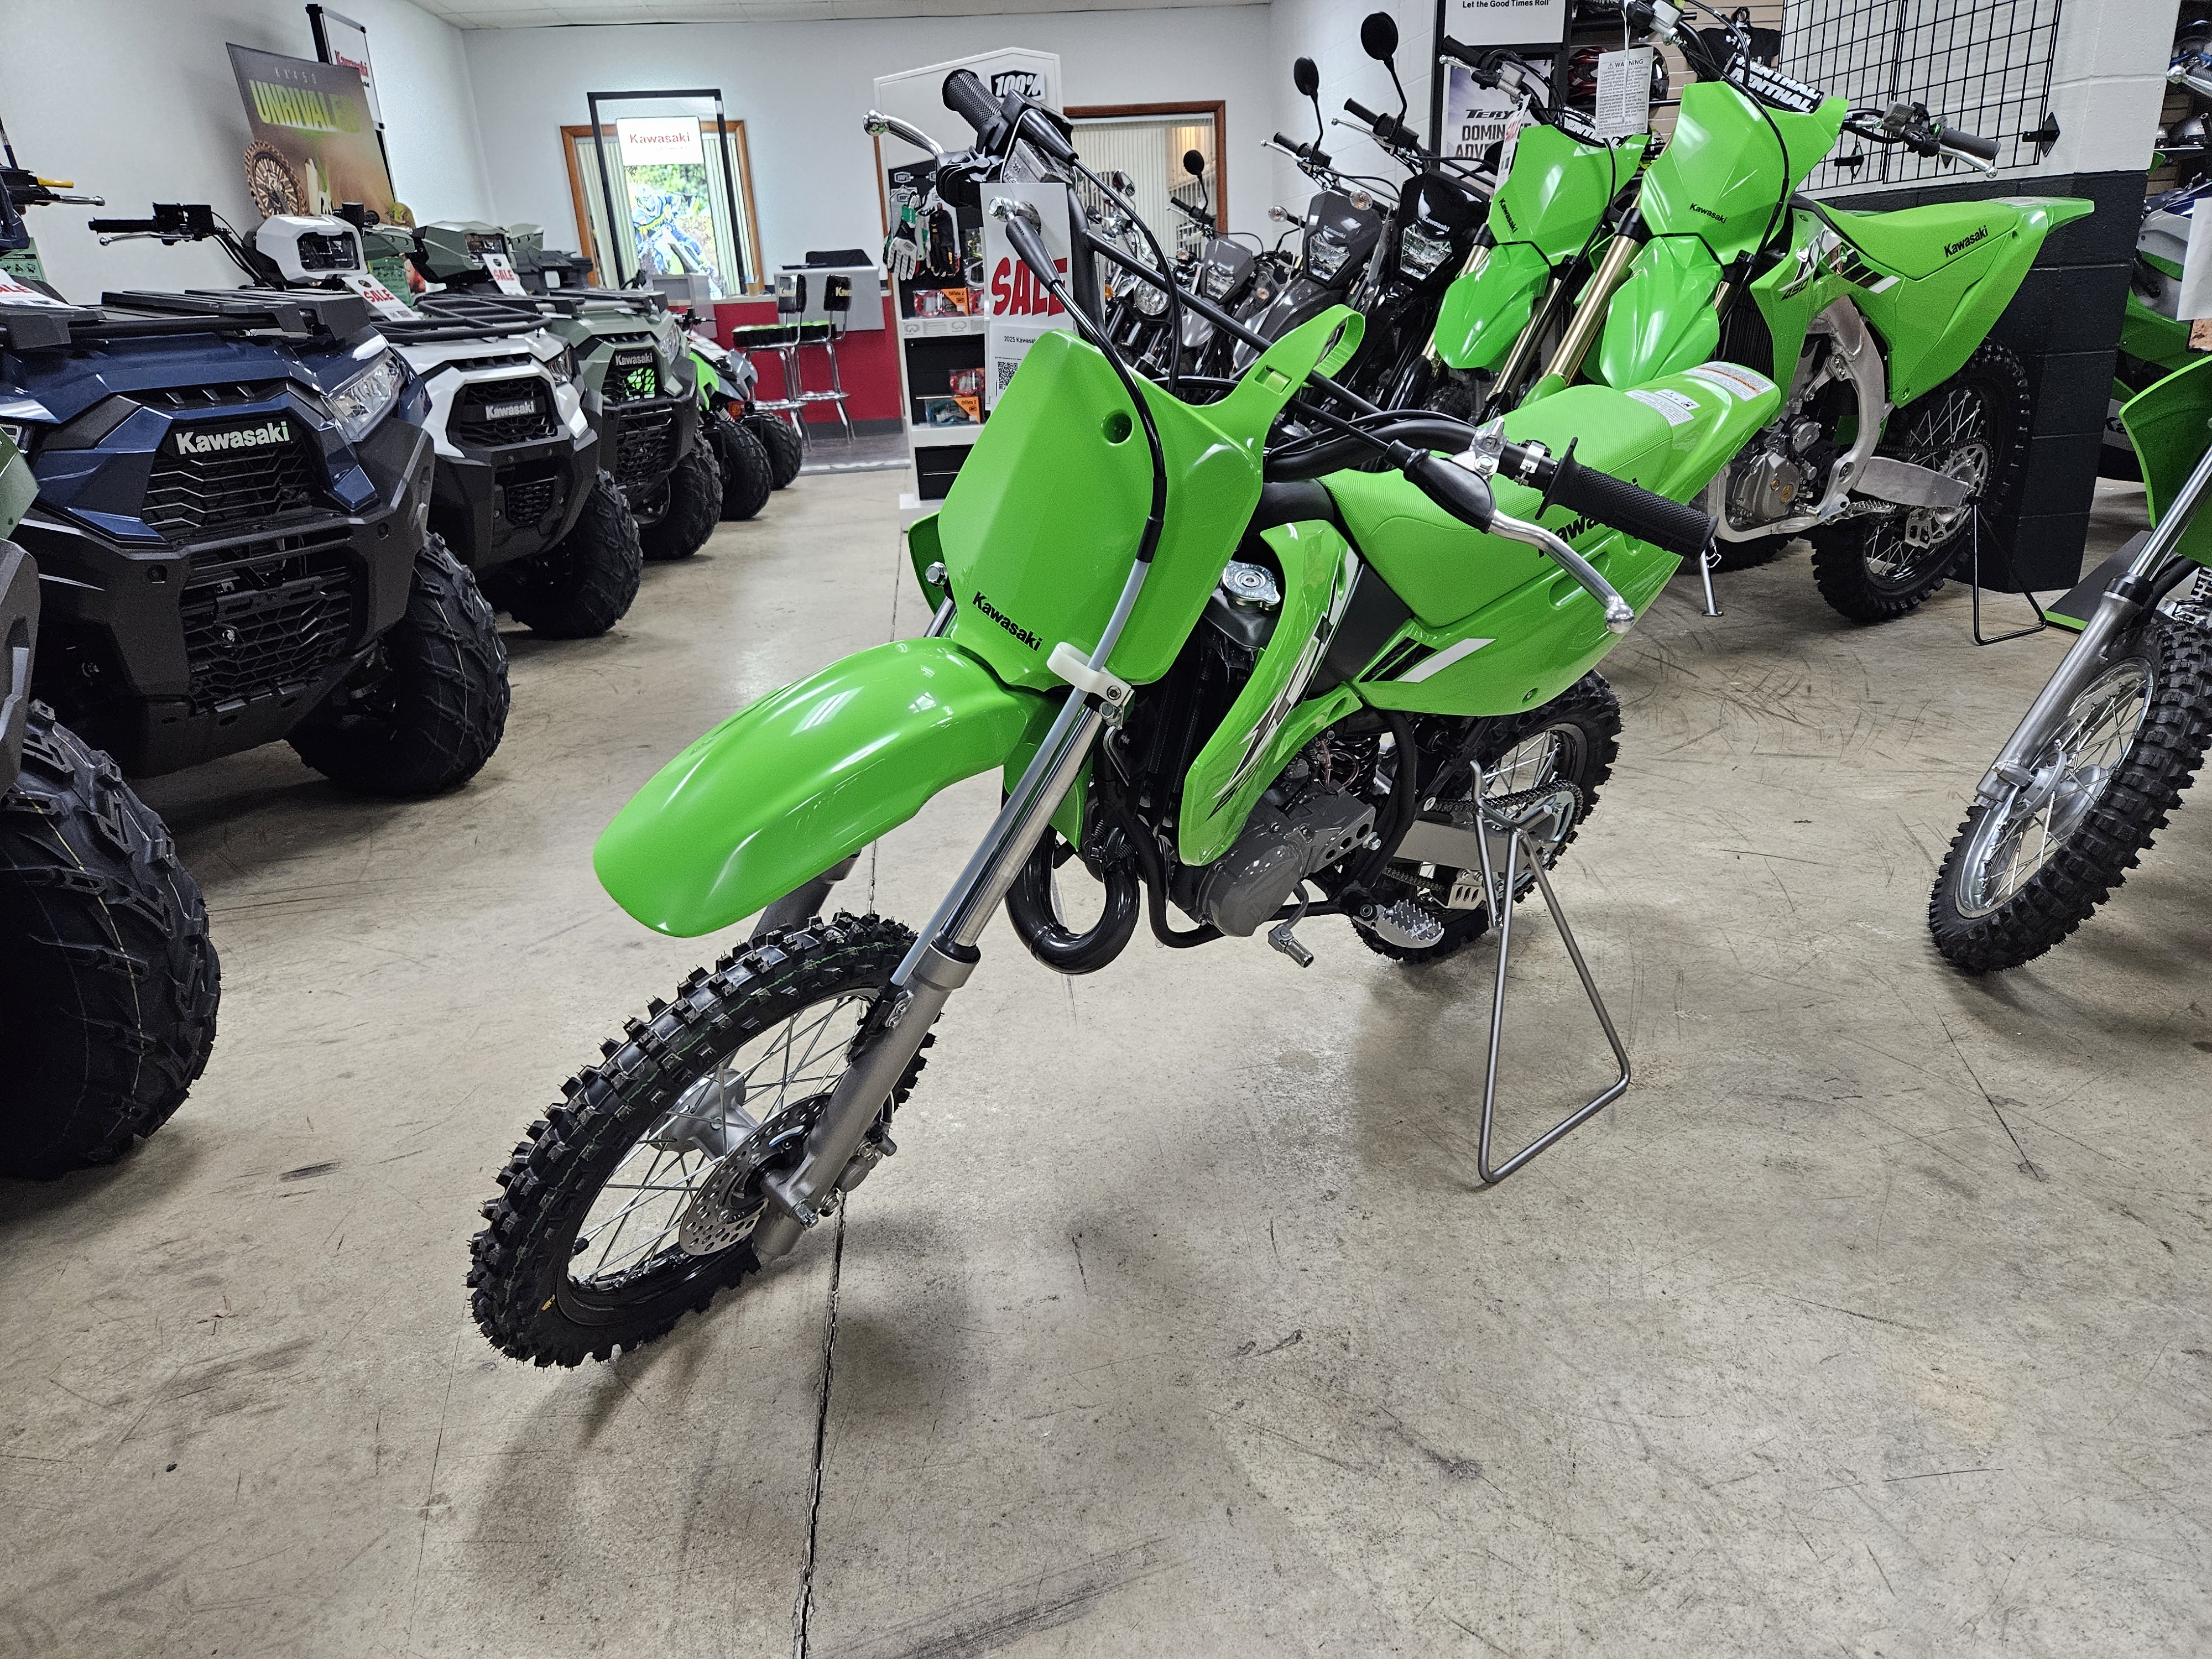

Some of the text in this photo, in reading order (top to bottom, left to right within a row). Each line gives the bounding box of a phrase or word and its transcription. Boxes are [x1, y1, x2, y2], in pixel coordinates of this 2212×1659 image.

[1615, 59, 1644, 68] WANING
[995, 74, 1040, 96] 100%
[1729, 67, 1812, 113] RENTHAL
[1465, 109, 1517, 120] TERY
[629, 132, 690, 144] Kawasaki
[1422, 215, 1451, 232] Kawasaki
[1499, 197, 1518, 233] Kawasaki
[1689, 203, 1728, 224] Kawasaki
[1944, 225, 1989, 258] Kawasaki
[493, 268, 515, 281] SALE
[0, 284, 34, 294] ALE
[363, 289, 395, 302] SALE
[991, 257, 1068, 317] SALE
[1780, 276, 1810, 301] 450
[615, 352, 653, 366] Kawasaki
[485, 400, 535, 421] Kawasaki
[175, 421, 290, 455] Kawasaki
[972, 591, 1044, 652] Kawasaki
